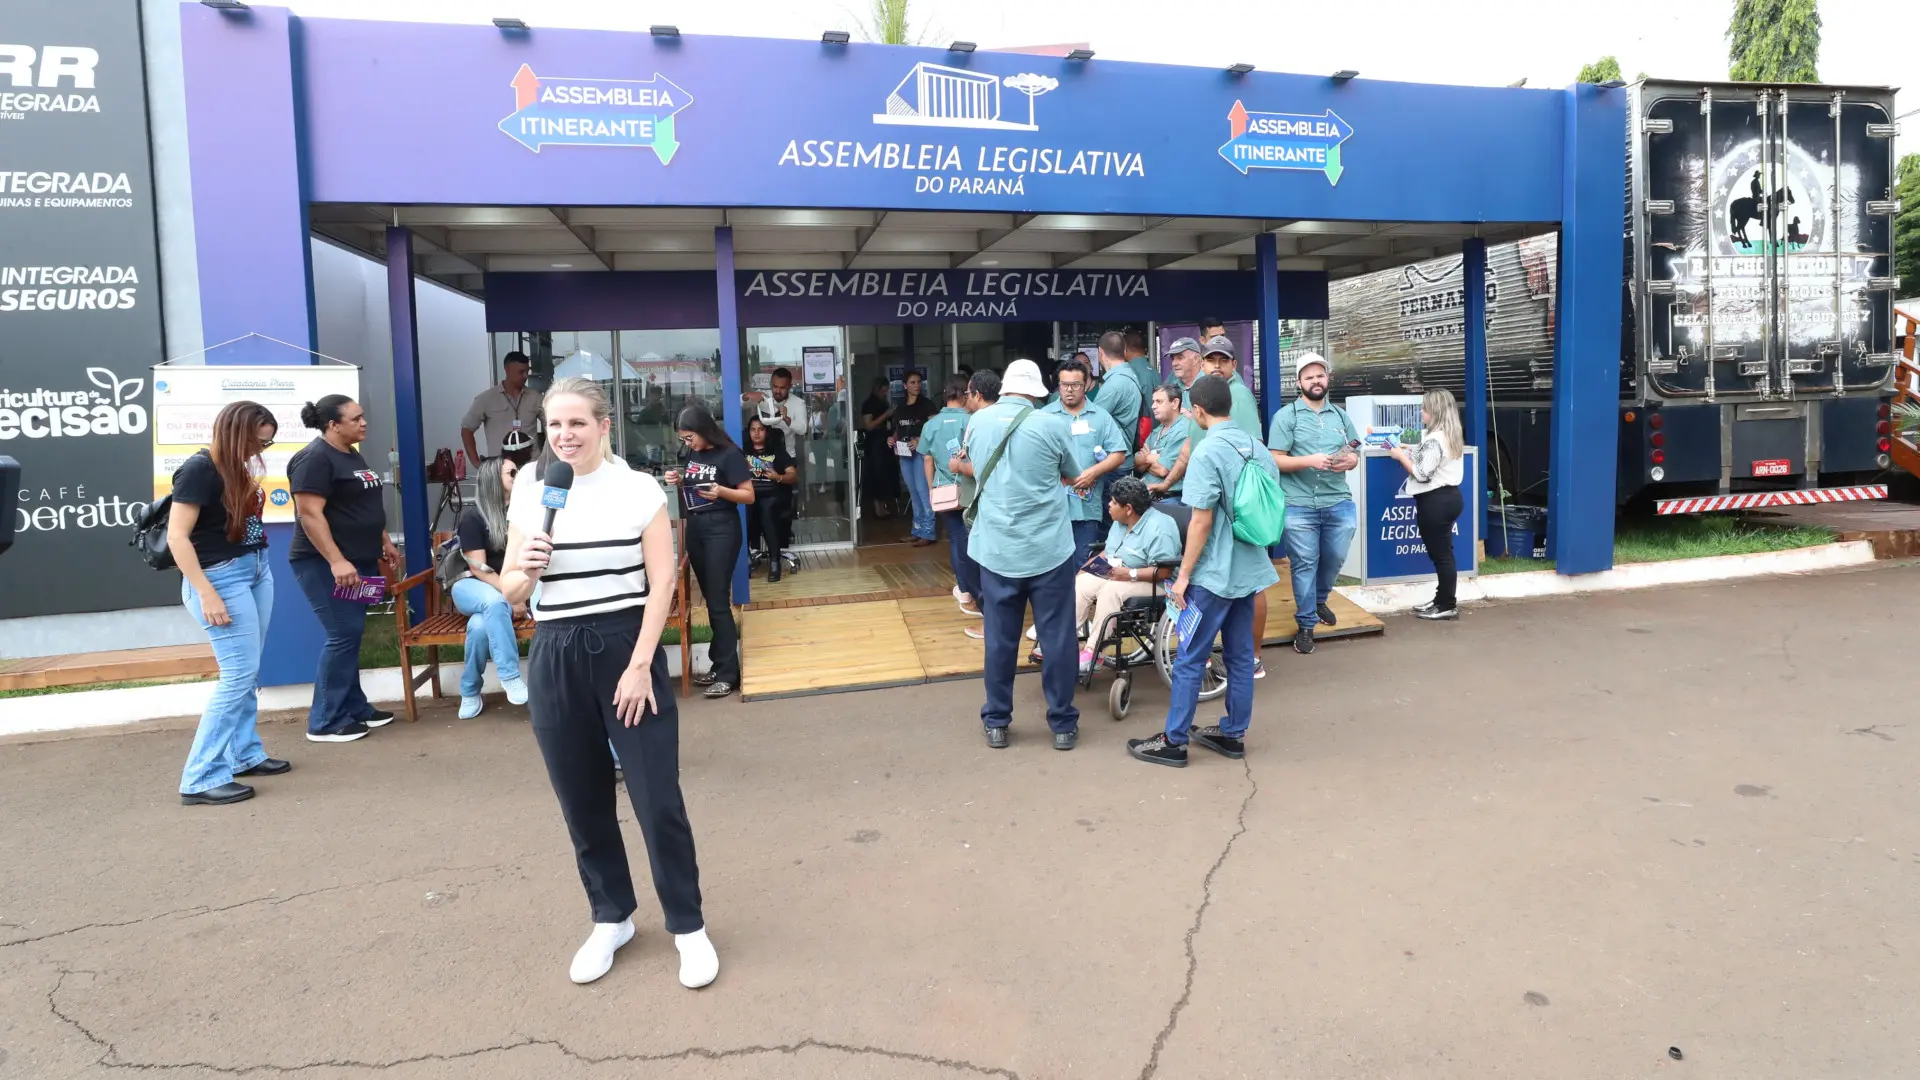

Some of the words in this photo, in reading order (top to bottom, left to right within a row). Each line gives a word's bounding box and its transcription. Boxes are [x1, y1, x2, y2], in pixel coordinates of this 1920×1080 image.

[0, 92, 101, 113] EGRADA
[541, 86, 674, 107] ASSEMBLEIA
[520, 117, 653, 138] ITINERANTE
[1248, 119, 1341, 137] ASSEMBLEIA
[779, 139, 963, 171] ASSEMBLEIA
[977, 146, 1146, 177] LEGISLATIVA
[1234, 144, 1326, 163] ITINERANTE
[915, 176, 944, 193] DO
[948, 175, 1025, 196] PARANÁ
[34, 198, 41, 207] E
[44, 198, 133, 208] EQUIPAMENTOS
[1, 266, 139, 285] INTEGRADA
[744, 272, 949, 297] ASSEMBLEIA
[966, 273, 1150, 298] LEGISLATIVA
[0, 288, 136, 311] SEGUROS
[897, 301, 929, 317] DO
[933, 298, 1018, 318] PARANÁ
[18, 484, 86, 502] CAFÉ
[1396, 545, 1409, 555] DO
[1411, 543, 1428, 554] PAR
